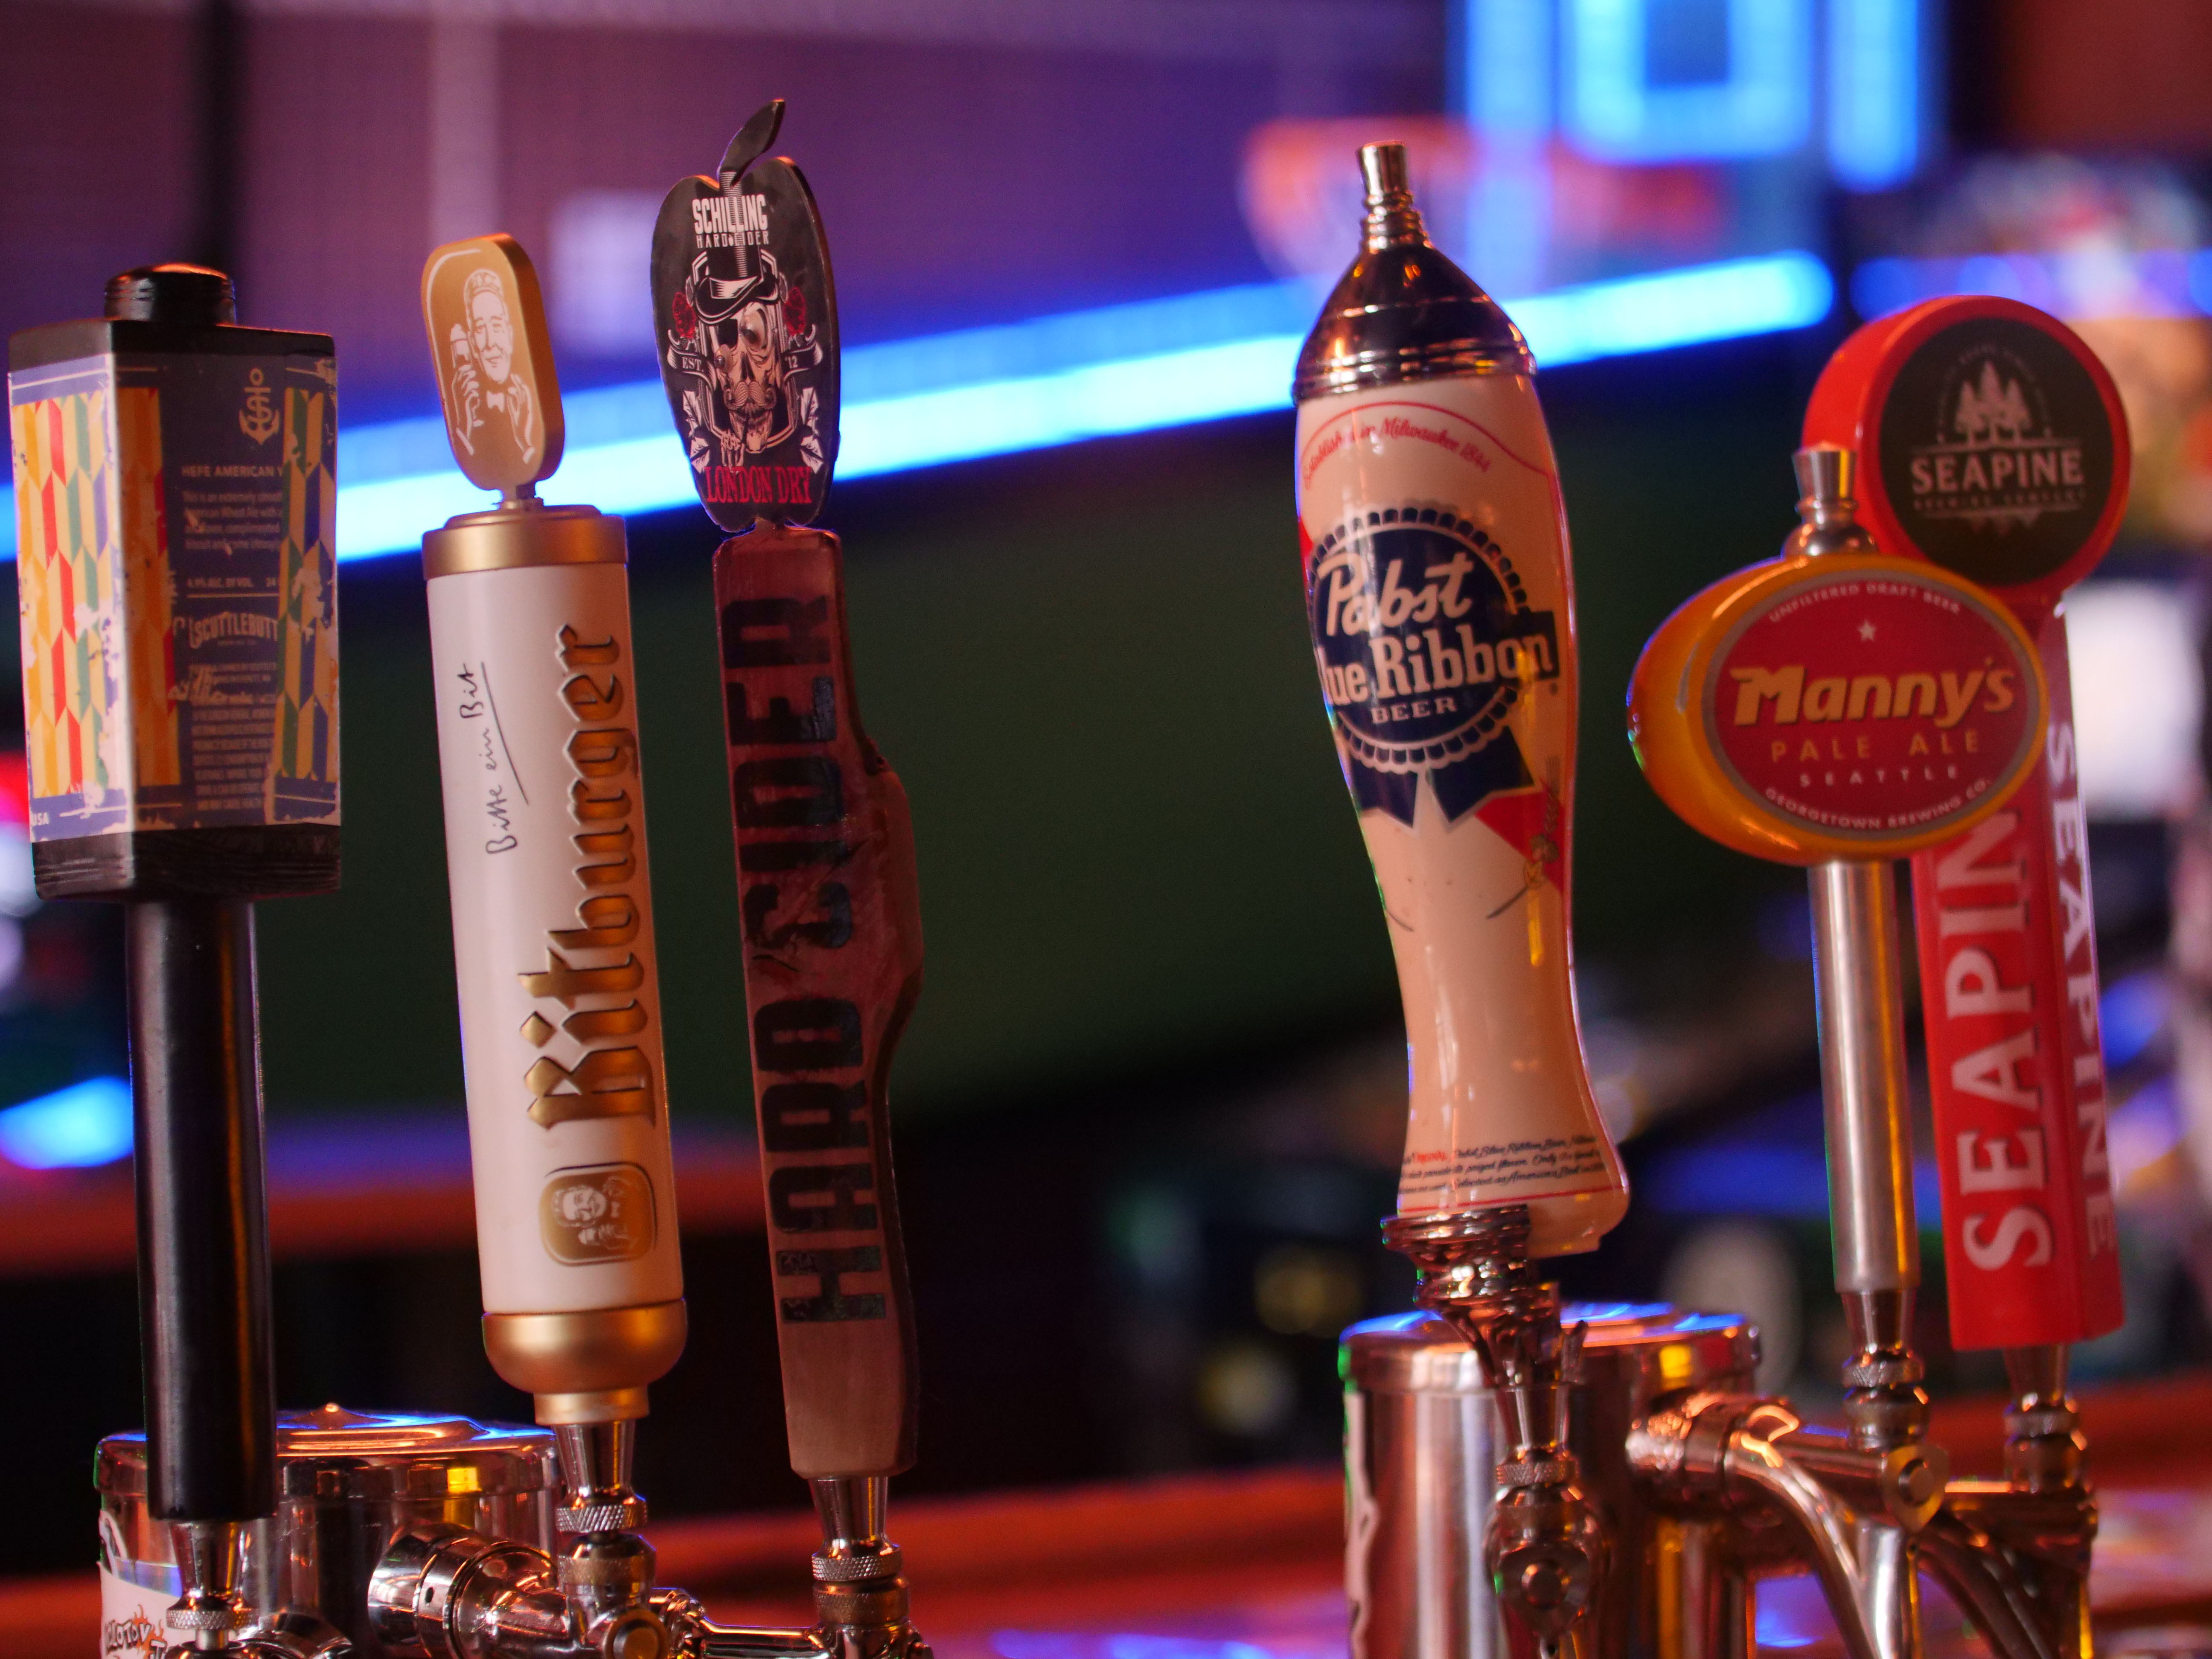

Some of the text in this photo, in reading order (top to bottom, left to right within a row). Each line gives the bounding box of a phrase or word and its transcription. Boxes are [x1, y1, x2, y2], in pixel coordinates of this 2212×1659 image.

[692, 194, 768, 234] SCHILLING
[696, 230, 769, 249] HARD CIDER
[681, 356, 704, 372] EST.
[214, 465, 274, 477] AMERICAN
[704, 466, 812, 504] LONDON DRY
[1910, 448, 2084, 495] SEAPINE
[1317, 551, 1474, 637] Pabst
[1866, 582, 1918, 598] DRAFT
[1923, 591, 1960, 615] BEER
[1368, 623, 1553, 699] Ribbon
[1370, 696, 1458, 725] BEER
[1729, 656, 2015, 730] Manny's
[457, 663, 518, 855] Bitte ein Bit
[1770, 728, 1979, 763] PALE ALE
[1799, 764, 1959, 788] SEATTLE
[1765, 787, 1881, 829] GEORGETOWN
[1887, 796, 1962, 828] BREWING
[518, 623, 657, 1131] Bitburger
[721, 595, 886, 1324] HARD CIDER
[1934, 811, 2056, 1272] SEAPIN
